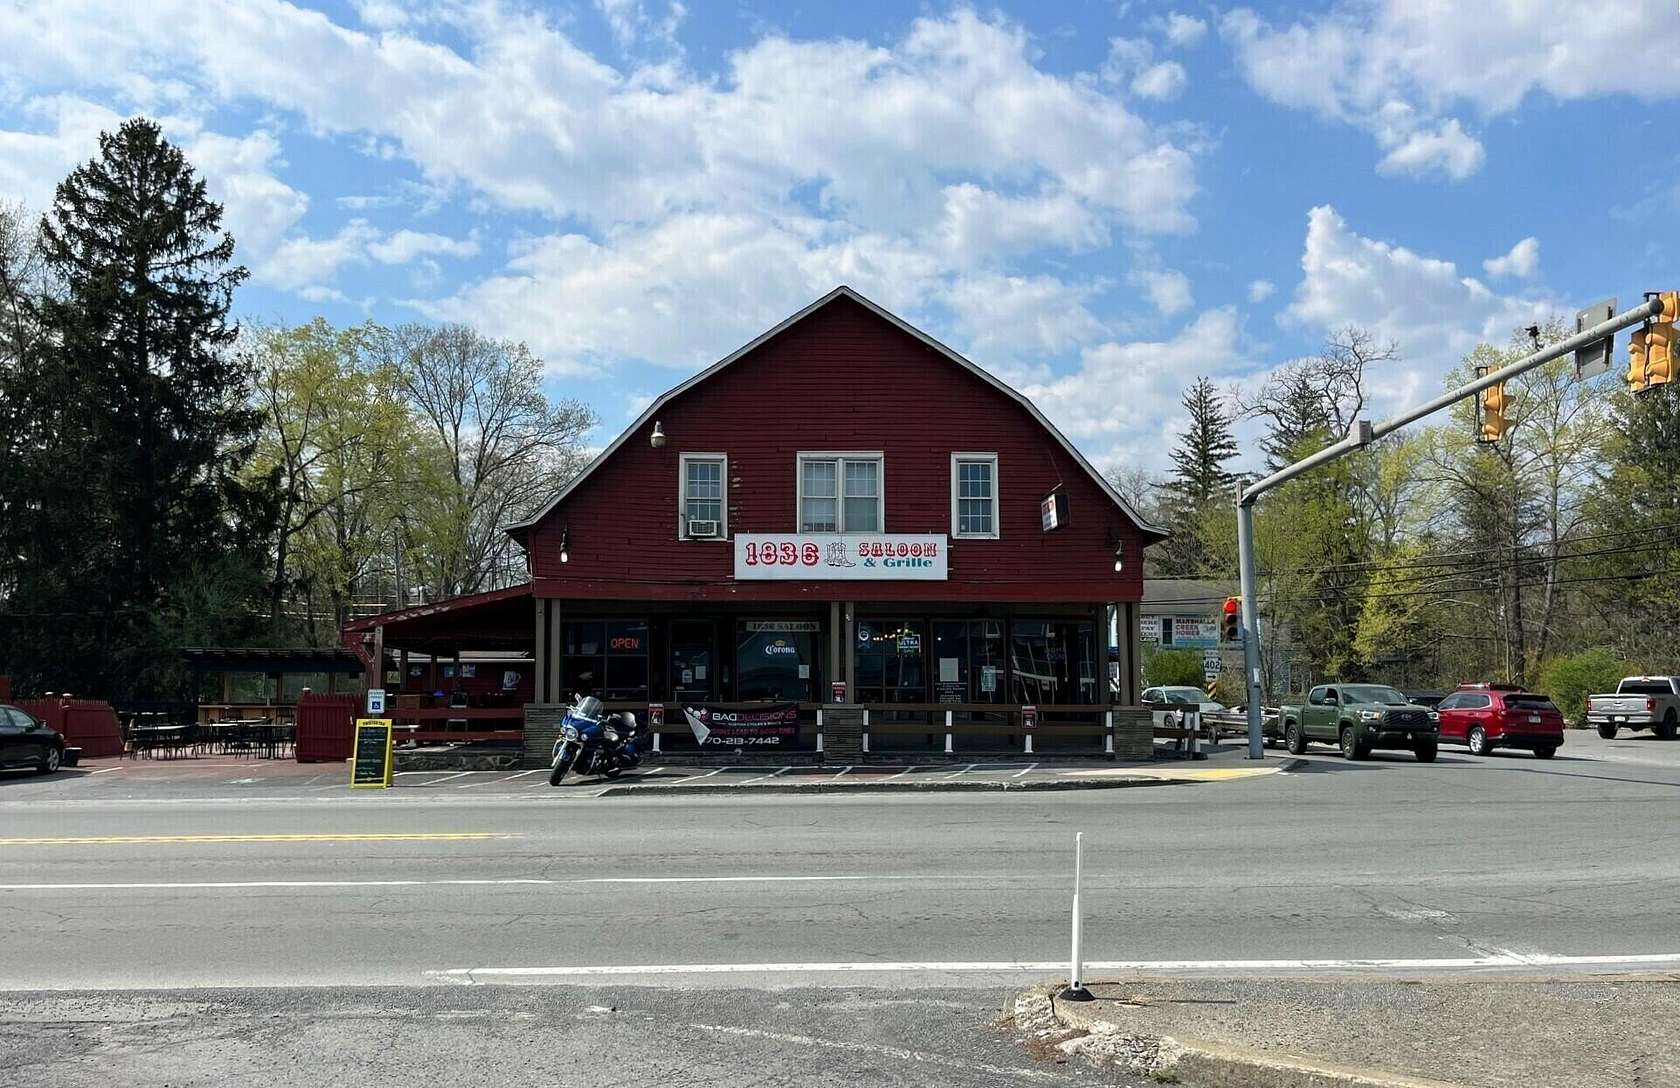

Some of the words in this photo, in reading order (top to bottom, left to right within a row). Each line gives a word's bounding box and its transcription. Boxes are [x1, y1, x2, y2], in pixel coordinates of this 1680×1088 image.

[745, 542, 819, 567] 1836
[858, 543, 937, 557] SALOON
[863, 557, 877, 568] &
[883, 557, 933, 568] Grille
[610, 638, 640, 649] OPEN
[765, 645, 796, 655] Corona
[1205, 660, 1220, 670] 402
